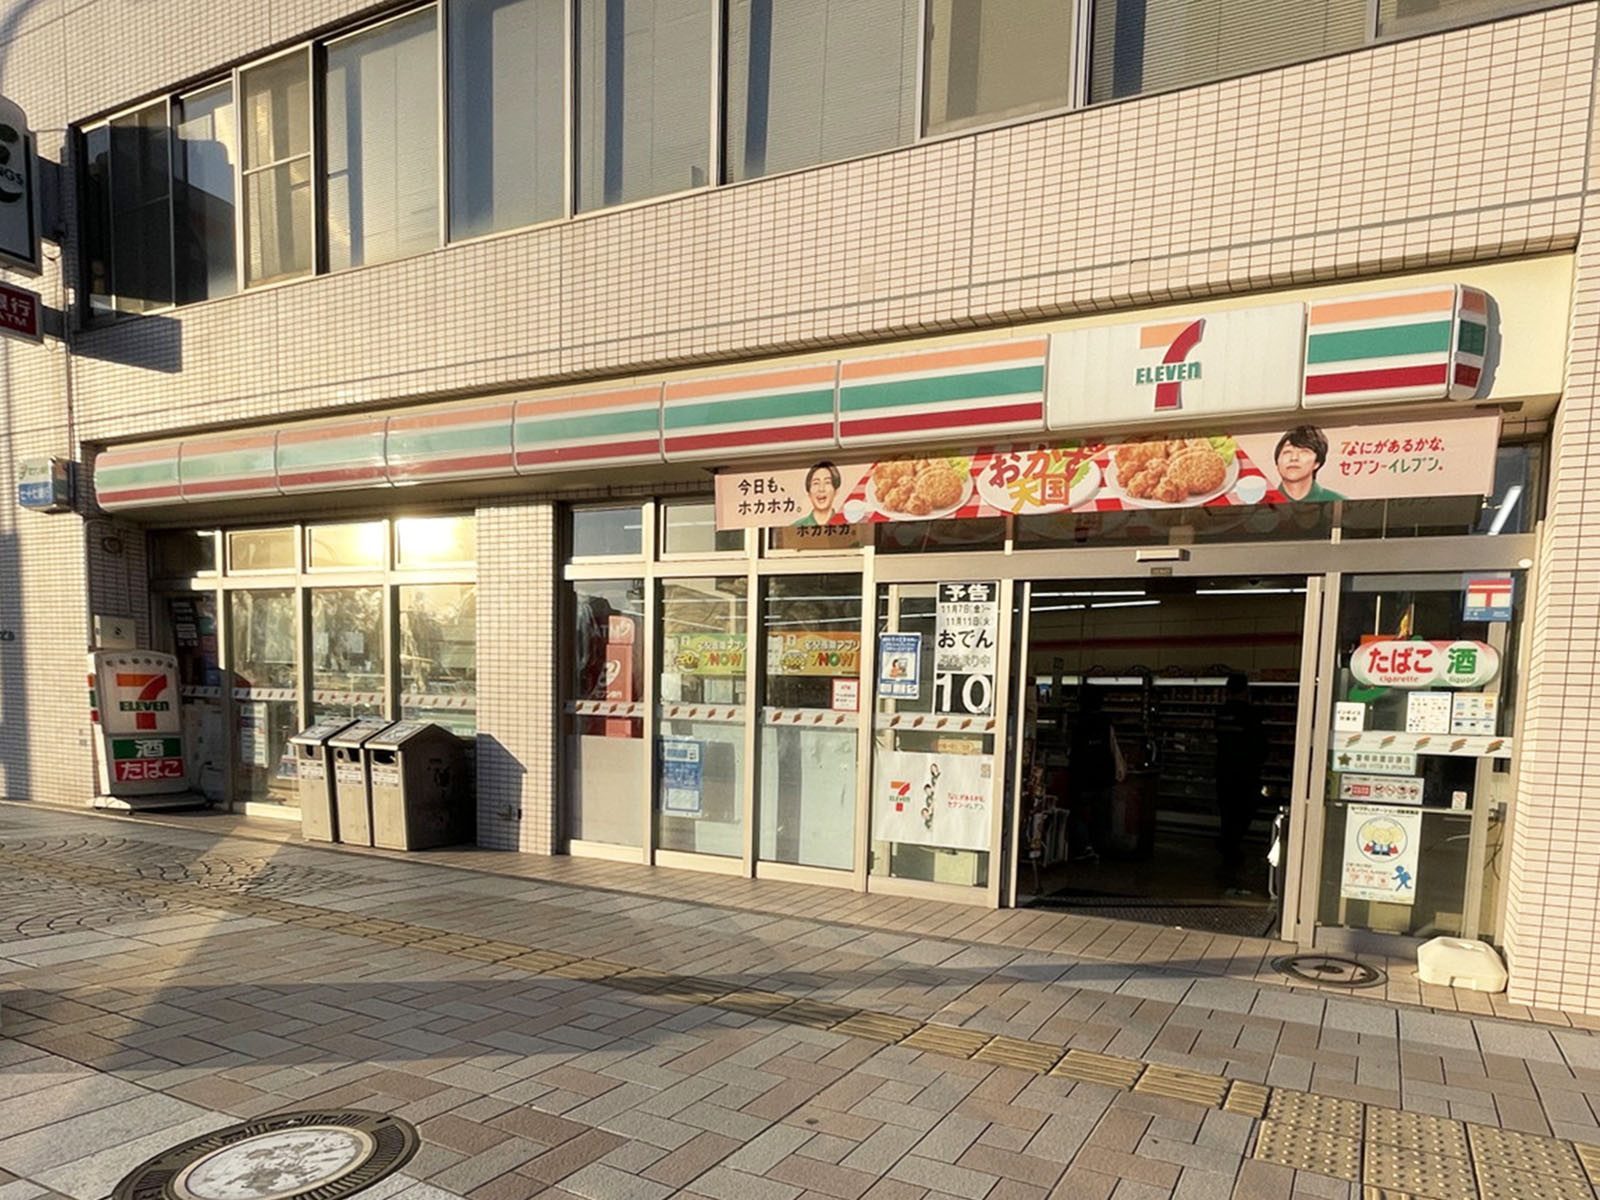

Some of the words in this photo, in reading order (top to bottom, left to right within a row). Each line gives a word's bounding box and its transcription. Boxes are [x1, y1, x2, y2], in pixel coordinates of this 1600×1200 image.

[1007, 473, 1072, 515] 天国
[945, 584, 990, 601] 予告
[938, 629, 993, 648] おでん
[1368, 647, 1433, 674] たばこ
[1447, 648, 1478, 674] 酒
[935, 674, 992, 714] 10
[135, 740, 164, 757] 酒
[120, 762, 181, 780] たばこ
